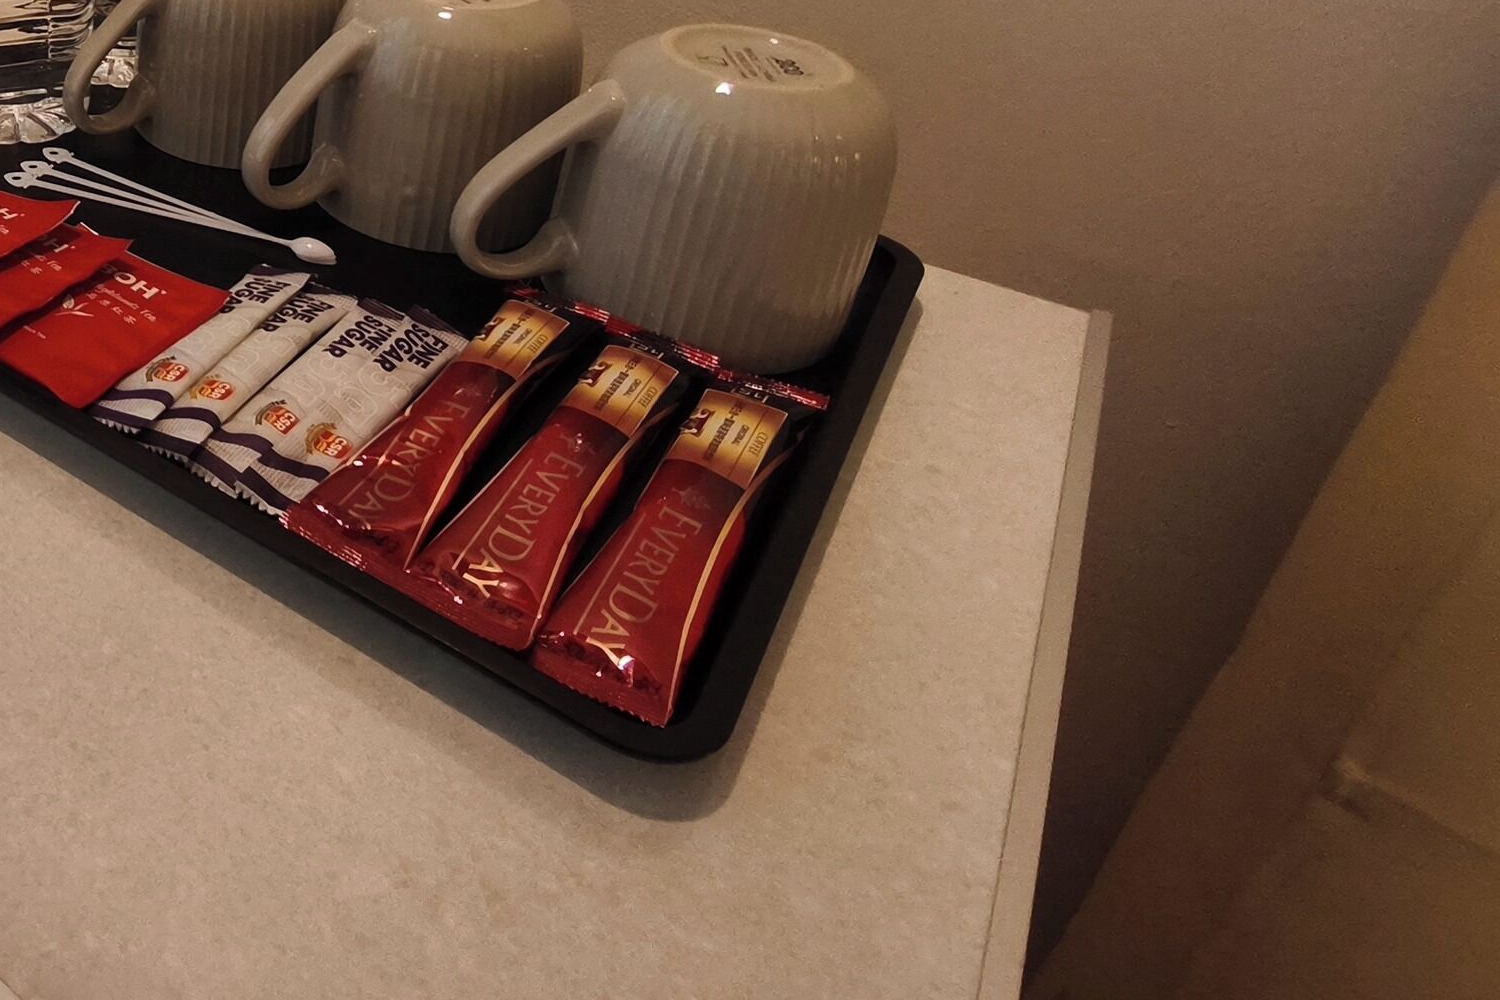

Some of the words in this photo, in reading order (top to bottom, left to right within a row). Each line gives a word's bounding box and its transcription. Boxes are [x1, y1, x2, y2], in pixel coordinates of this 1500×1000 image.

[248, 280, 291, 304] FINE
[293, 299, 334, 323] FINE
[321, 314, 383, 358] SUGAR
[359, 324, 397, 352] FINE
[373, 323, 431, 372] SUGAR
[407, 334, 449, 369] FINE
[164, 364, 186, 381] CSR
[208, 383, 230, 399] CSR
[273, 412, 296, 431] CSR
[323, 437, 347, 456] CSR
[462, 449, 588, 599] EVERYDAY
[585, 505, 703, 673] EVERYDAY
